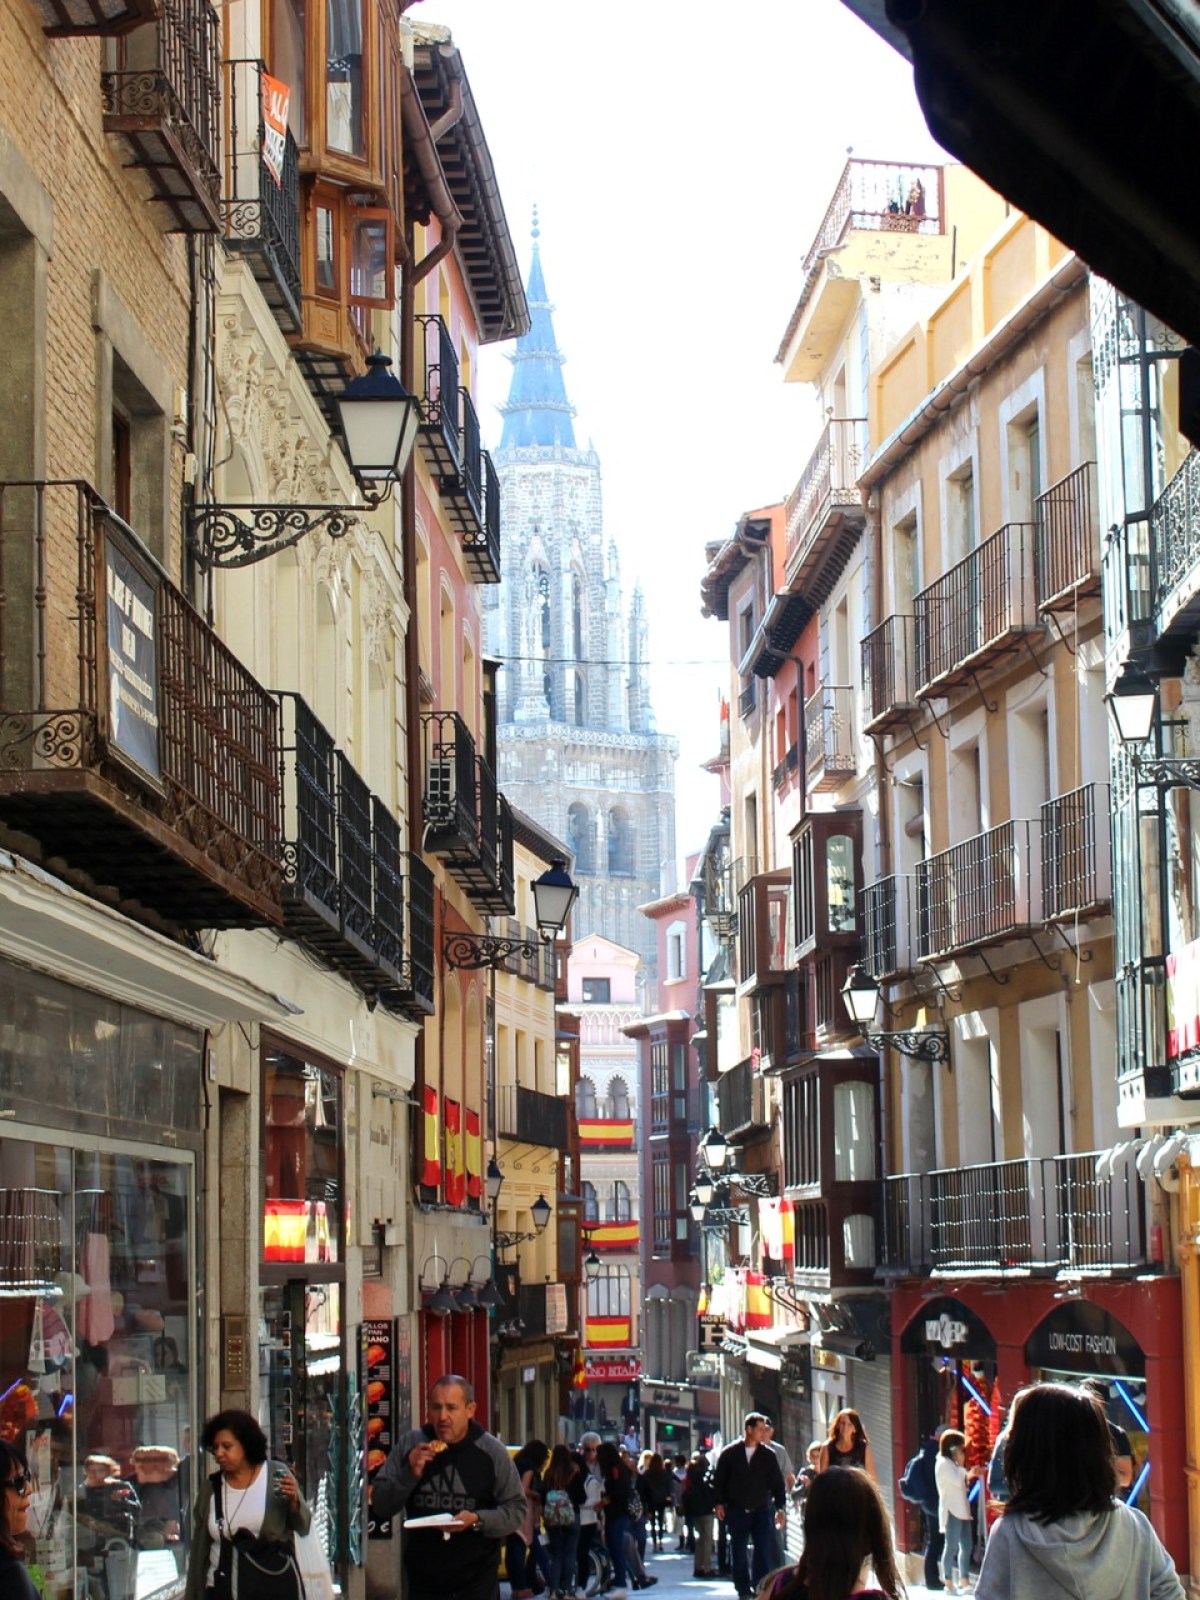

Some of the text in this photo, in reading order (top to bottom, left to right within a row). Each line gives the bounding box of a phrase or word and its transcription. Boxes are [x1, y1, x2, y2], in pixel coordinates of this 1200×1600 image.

[700, 1315, 729, 1323] HOSTA
[1048, 1332, 1117, 1355] LOW-COST FASHION
[414, 1492, 476, 1510] adidas
